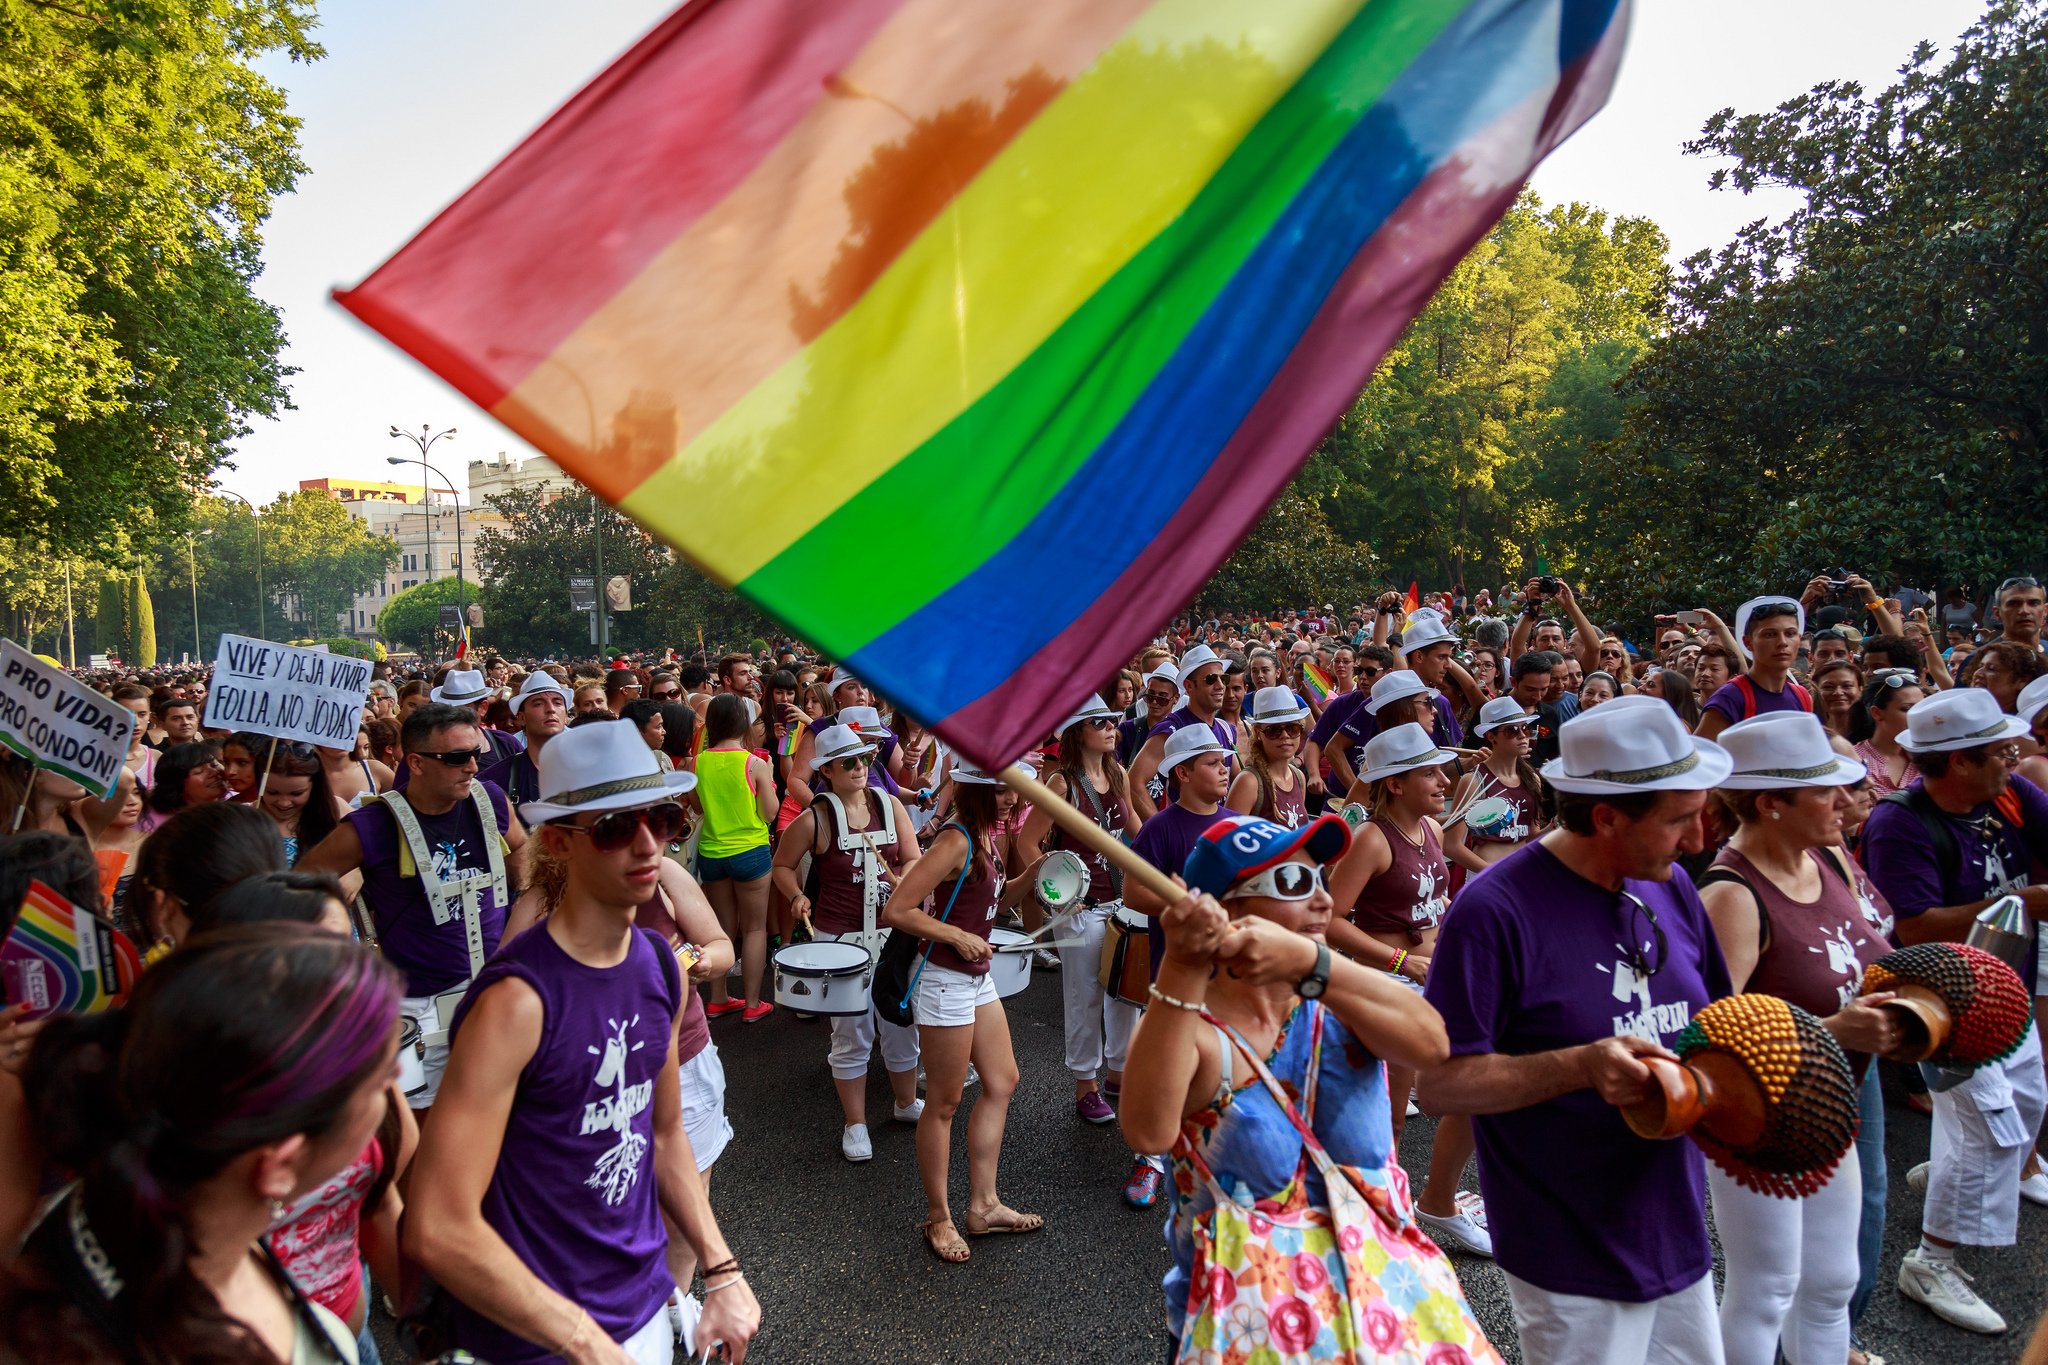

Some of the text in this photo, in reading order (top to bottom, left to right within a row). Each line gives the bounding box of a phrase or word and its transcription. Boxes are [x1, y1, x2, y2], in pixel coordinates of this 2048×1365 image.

[227, 640, 367, 693] VIVE Y DEJA VIVIR.
[4, 659, 129, 742] PRO VIDA?
[212, 685, 360, 741] FOLLA, NO JODAS.
[26, 716, 118, 782] CONDÓN!
